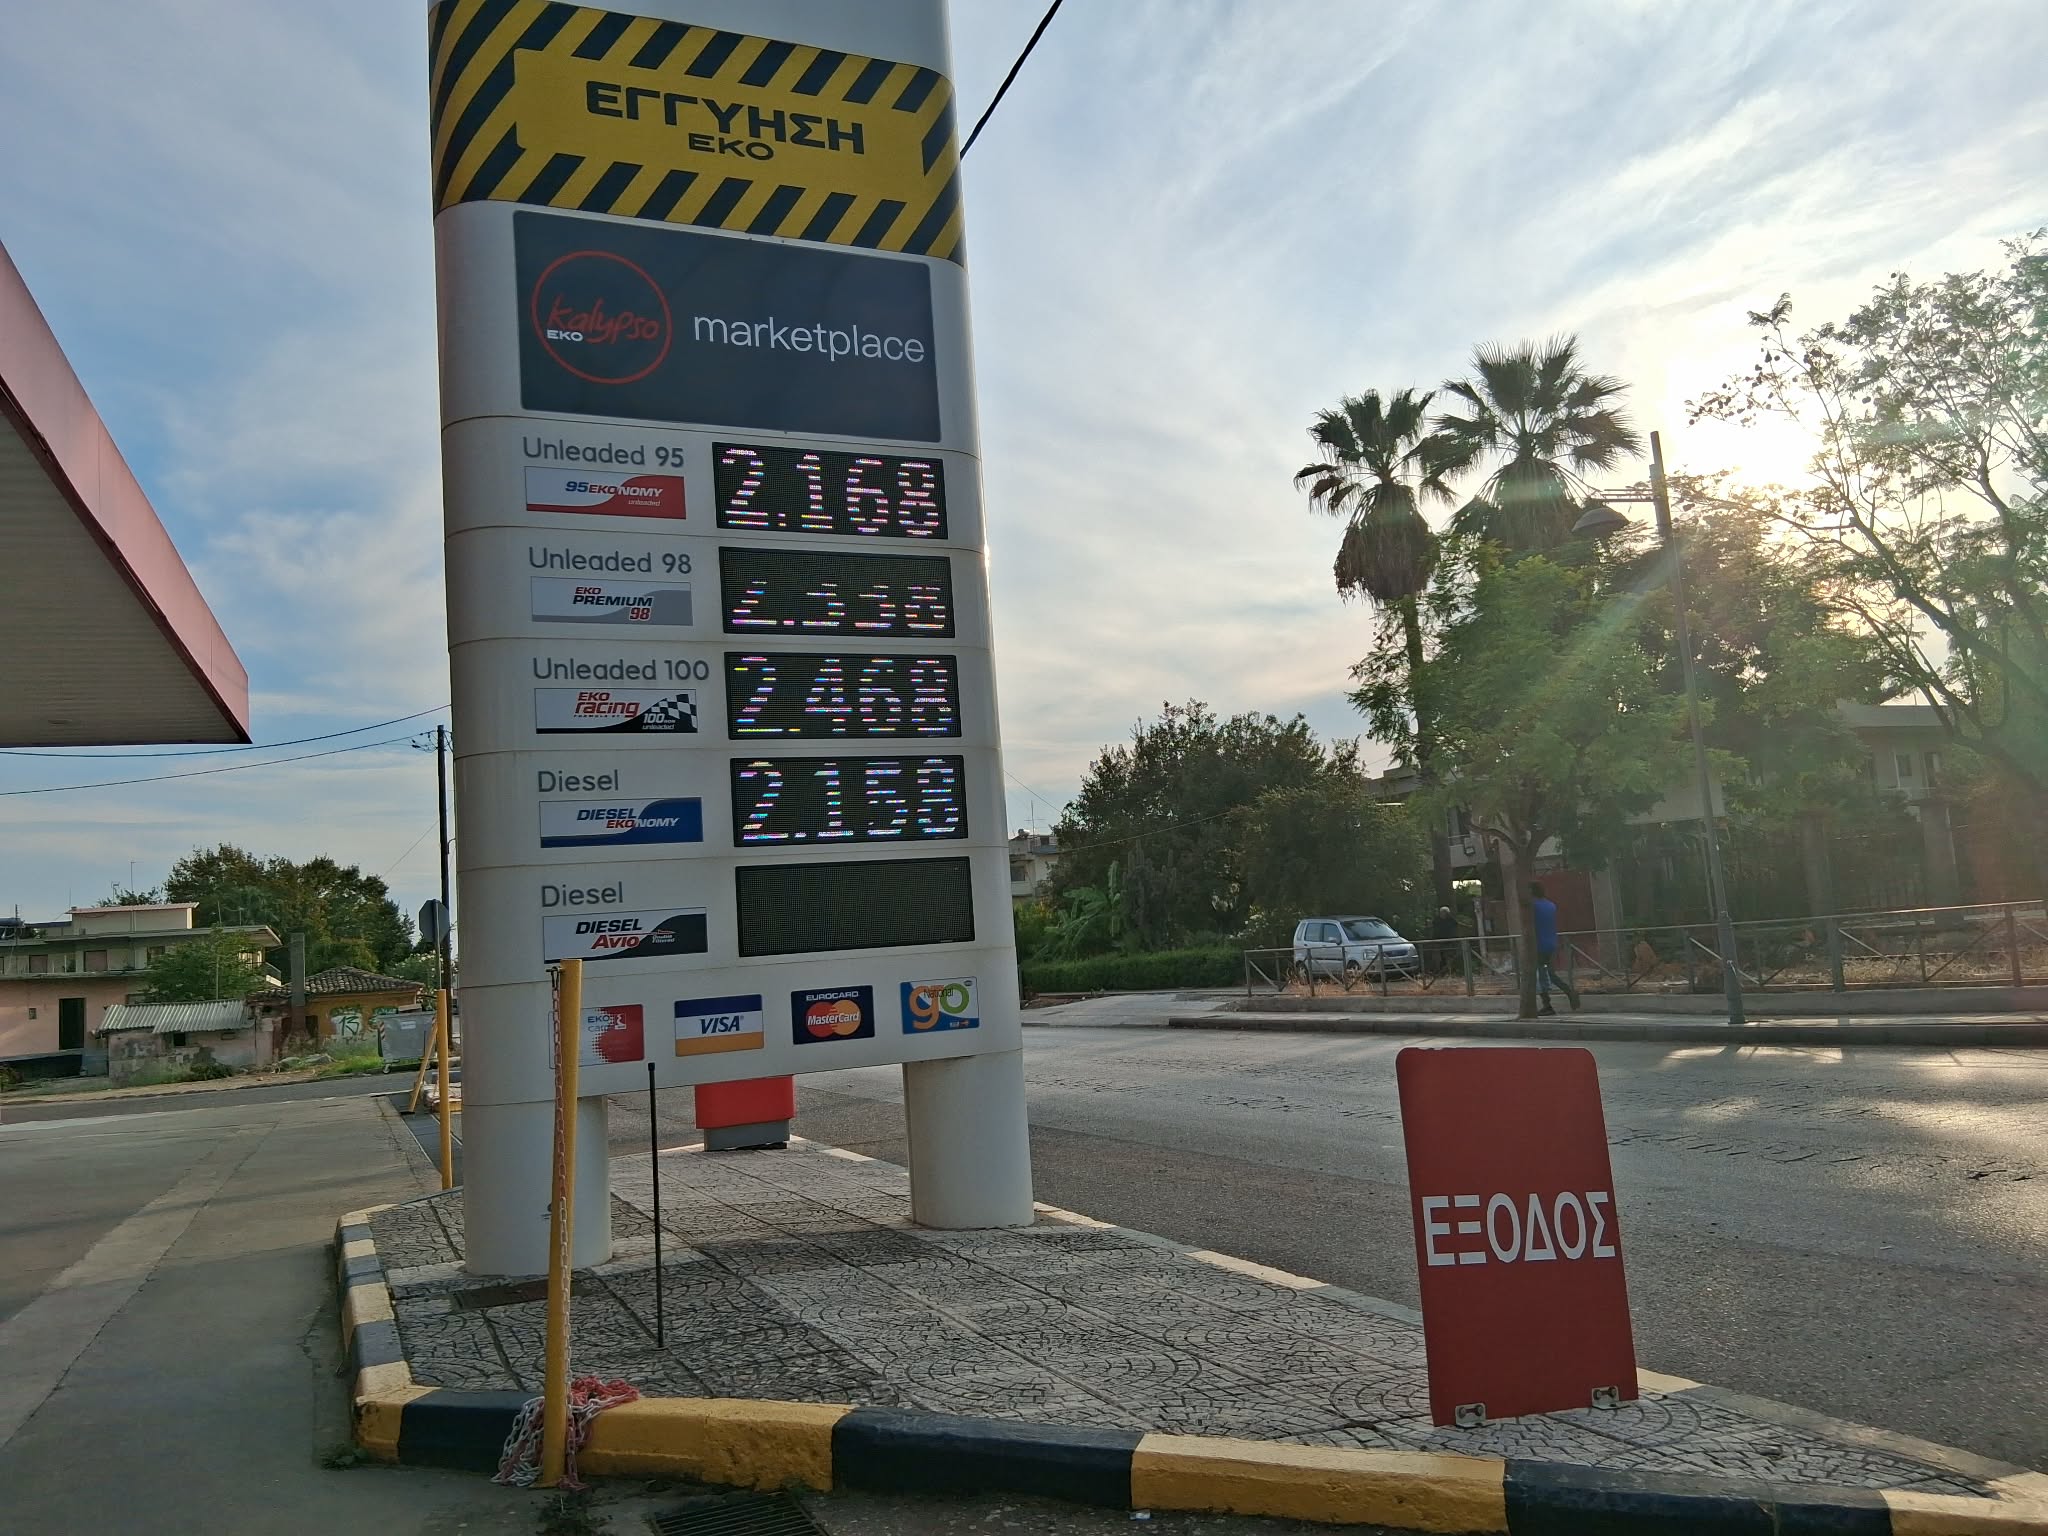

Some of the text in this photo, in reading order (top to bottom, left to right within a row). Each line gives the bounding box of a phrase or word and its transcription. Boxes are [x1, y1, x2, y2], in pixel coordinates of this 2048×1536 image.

[586, 80, 865, 155] ΕΓΓΥΗΣΗ
[546, 329, 584, 342] EKO
[693, 315, 925, 364] marketplace
[523, 436, 684, 468] Unleaded 95
[722, 448, 940, 536] 2.168
[529, 546, 692, 575] Unleaded 98
[574, 586, 602, 595] EKO
[572, 594, 653, 607] PREMIUM
[629, 607, 651, 620] 98
[533, 656, 710, 682] Unleaded 100
[577, 691, 611, 701] EKO
[574, 701, 641, 718] racing
[643, 713, 665, 724] 100
[538, 769, 619, 793] Diesel
[576, 808, 639, 821] DIESEL
[606, 817, 680, 829] EKONOMY
[541, 881, 624, 908] Diesel
[575, 918, 642, 935] DIESEL
[805, 990, 859, 1002] EUROCARD
[909, 982, 970, 1031] go
[587, 1014, 610, 1024] EKO
[700, 1015, 741, 1035] VISA
[807, 1012, 860, 1027] MasterCard
[1421, 1191, 1616, 1266] ΕΞΟΔΟΣ
